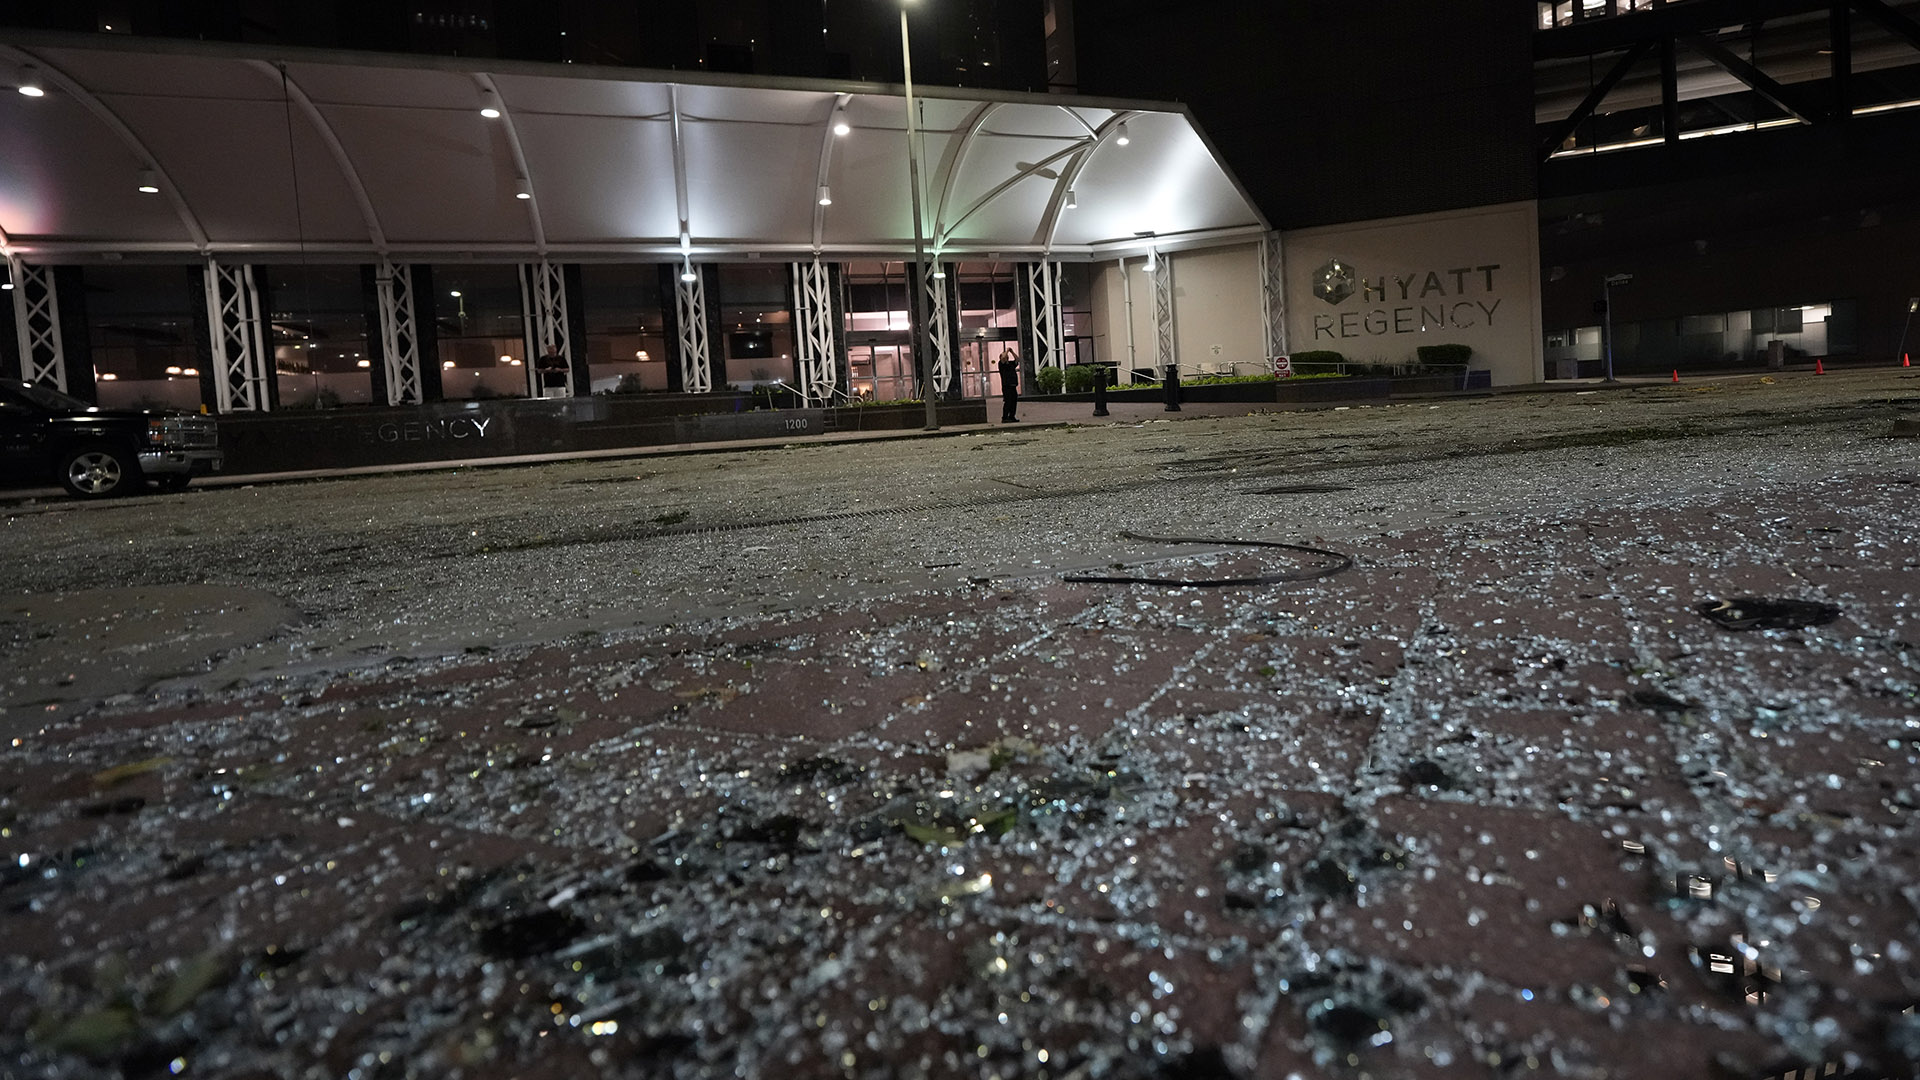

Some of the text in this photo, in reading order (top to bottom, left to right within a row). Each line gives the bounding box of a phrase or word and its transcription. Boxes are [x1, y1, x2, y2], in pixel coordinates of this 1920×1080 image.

[1363, 265, 1501, 302] HYATT
[1314, 299, 1502, 340] REGENCY
[352, 416, 491, 444] GENCY
[784, 418, 808, 430] 1200
